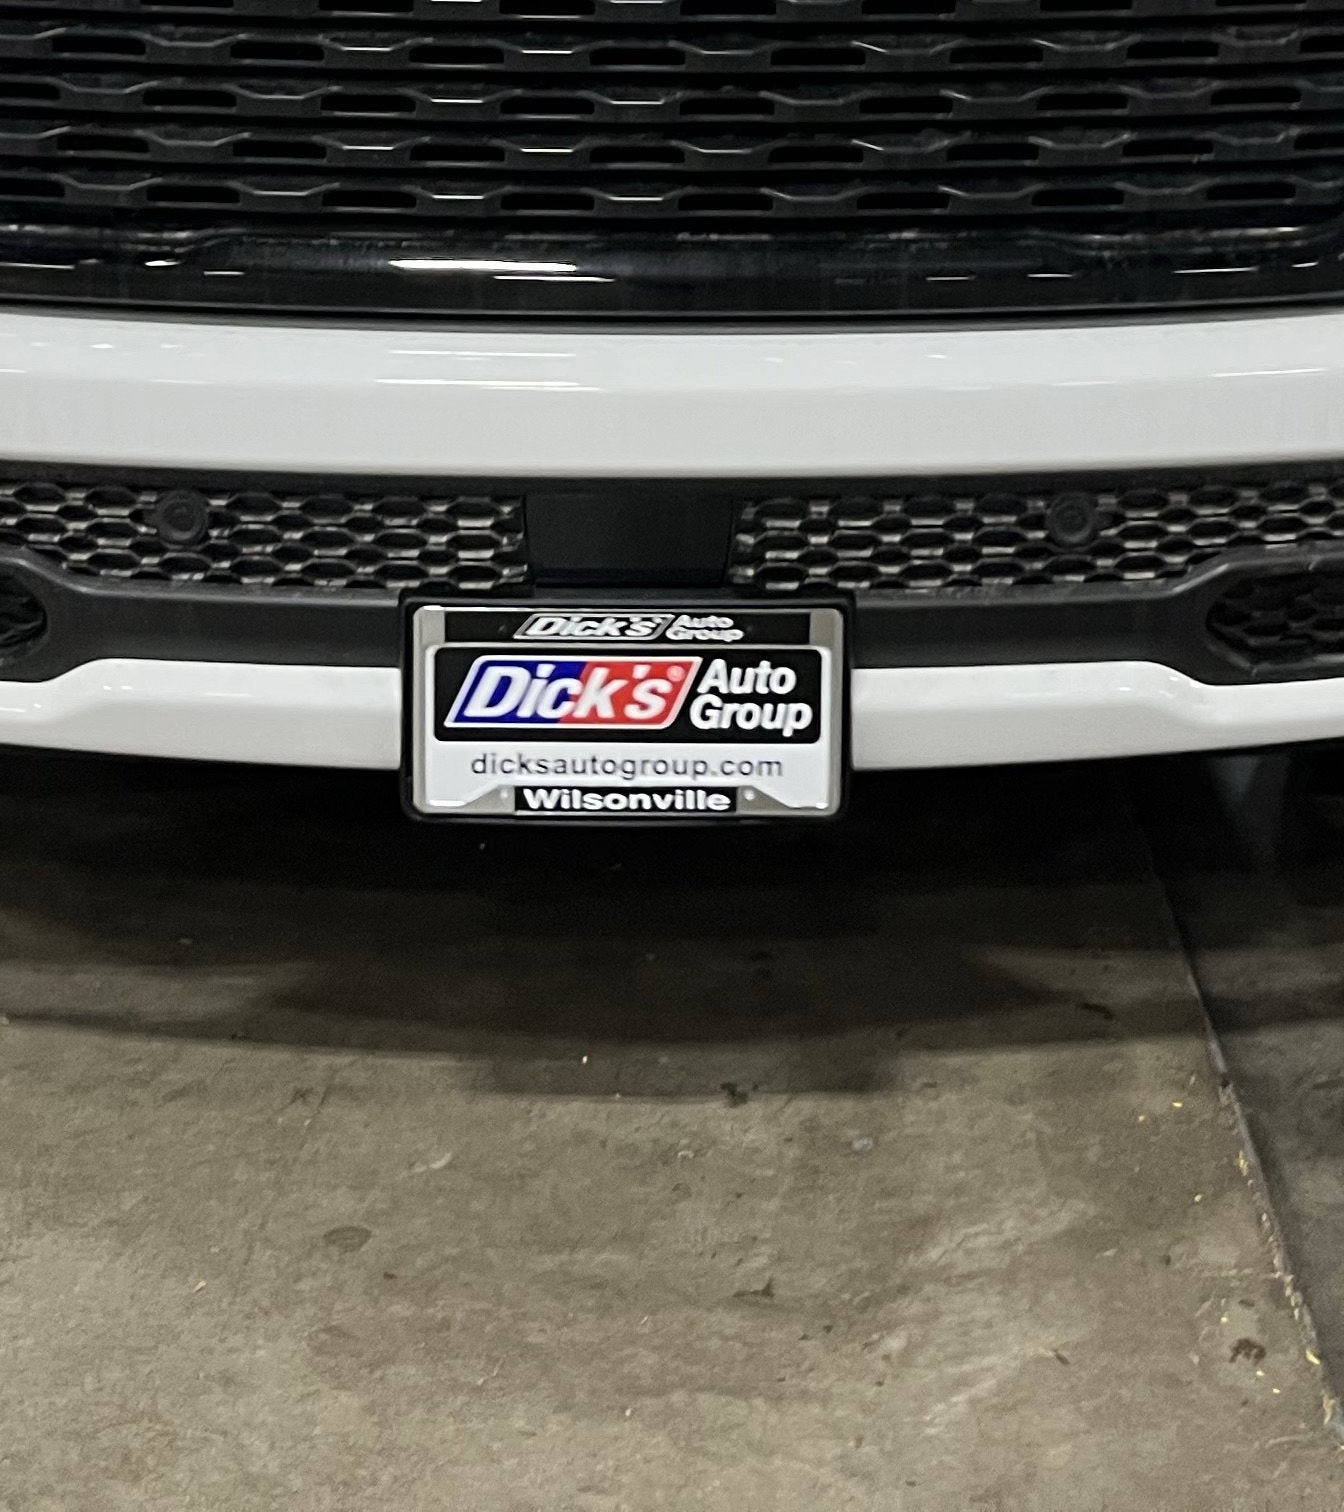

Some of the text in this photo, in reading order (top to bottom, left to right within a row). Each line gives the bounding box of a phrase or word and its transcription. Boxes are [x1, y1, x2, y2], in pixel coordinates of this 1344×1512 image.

[525, 615, 734, 637] Dick's Auto
[665, 628, 745, 643] Group
[464, 658, 798, 719] Dick's Auto
[689, 693, 813, 737] Group
[470, 752, 784, 781] dicksautogroup.com
[522, 788, 732, 812] Wilsonville
